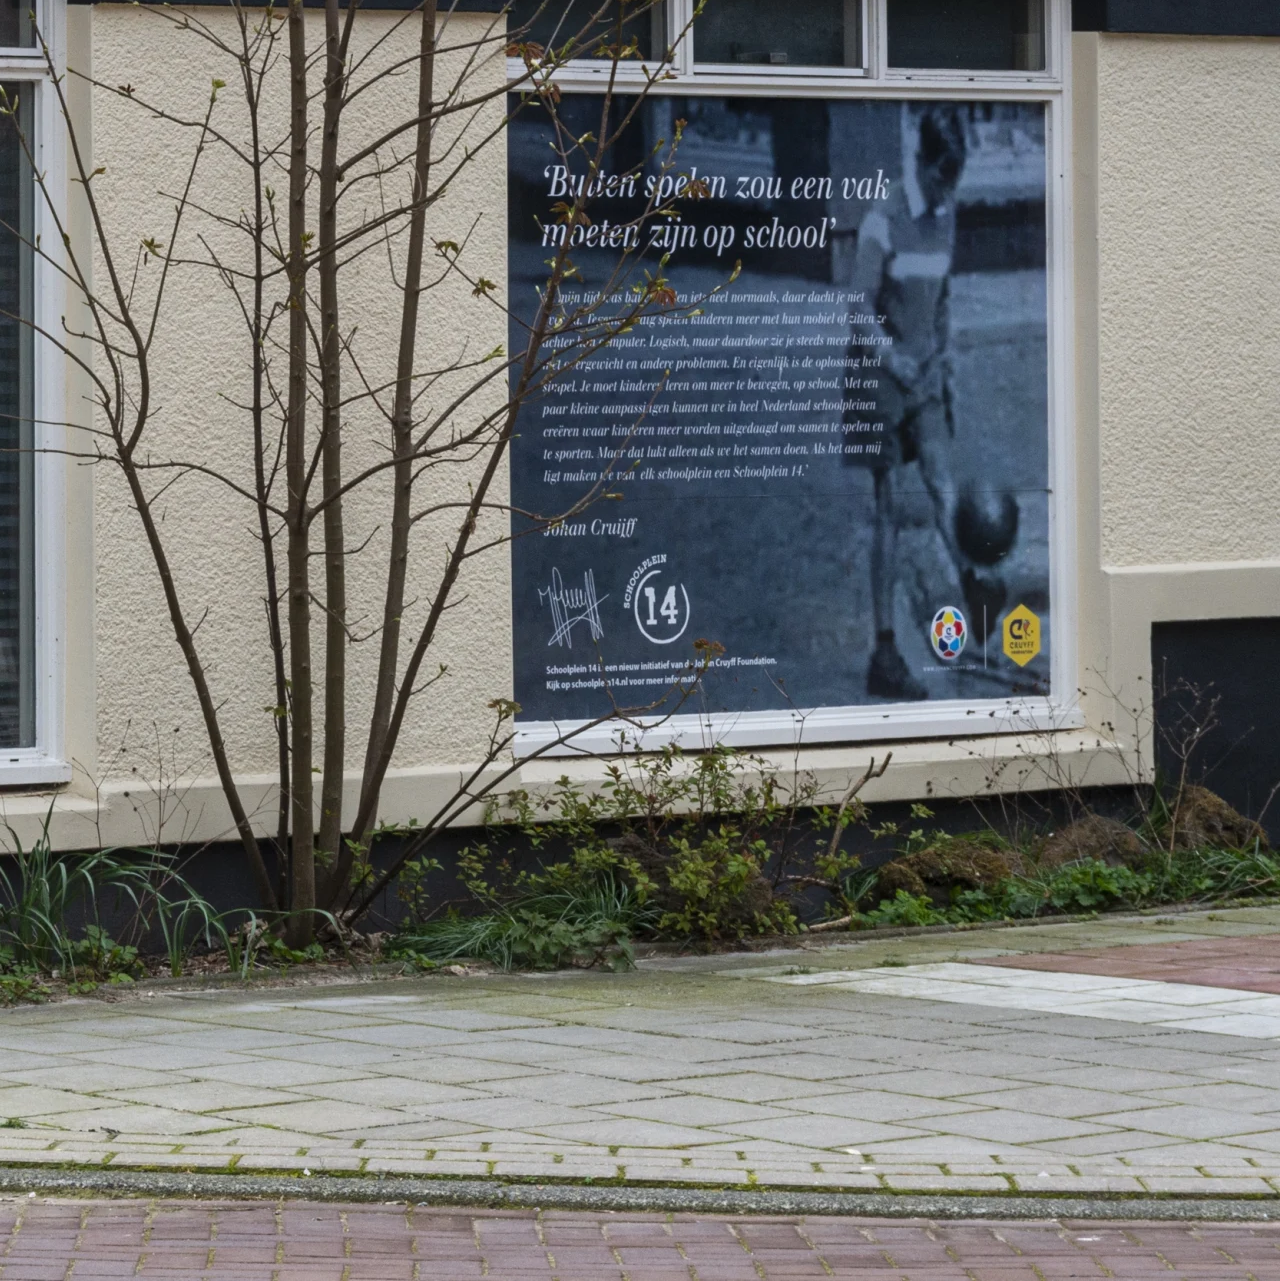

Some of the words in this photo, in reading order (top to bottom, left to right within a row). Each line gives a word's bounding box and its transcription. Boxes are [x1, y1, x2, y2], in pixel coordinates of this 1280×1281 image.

[736, 176, 783, 200] zou
[790, 175, 834, 199] een
[841, 169, 890, 200] vak
[649, 217, 697, 254] zijn
[703, 223, 735, 256] op
[544, 425, 580, 437] creëren
[582, 427, 609, 437] waar
[657, 426, 681, 435] meer
[683, 422, 721, 435] worden
[723, 421, 778, 437] uitgedaagd
[780, 424, 795, 433] om
[797, 424, 828, 433] samen
[830, 421, 839, 432] te
[841, 420, 870, 435] spelen
[872, 423, 883, 432] en
[544, 448, 553, 459] te
[627, 446, 645, 458] dat
[646, 445, 666, 458] lukt
[668, 445, 698, 457] alleen
[700, 444, 715, 457] als
[716, 447, 731, 456] we
[732, 444, 748, 456] het
[750, 446, 781, 456] samen
[811, 442, 826, 455] Als
[828, 442, 843, 454] het
[844, 445, 863, 454] aan
[865, 441, 881, 457] mij
[544, 470, 560, 486] ligt
[562, 469, 597, 482] maken
[638, 468, 655, 480] elk
[657, 466, 712, 483] schoolplein
[714, 469, 730, 478] een
[732, 465, 789, 481] Schoolplein
[591, 518, 638, 538] Cruijff
[623, 554, 667, 609] SCHOOLPLEIN
[644, 585, 679, 625] 14
[546, 663, 587, 676] Schoolplein
[588, 663, 596, 672] 14
[598, 663, 603, 672] i
[605, 664, 617, 672] een
[619, 661, 639, 671] nieuw
[641, 660, 669, 670] initiatief
[671, 661, 683, 669] van
[685, 659, 693, 669] d
[716, 657, 736, 669] Cruyff
[546, 679, 560, 691] Kijk
[561, 680, 570, 690] op
[572, 676, 628, 689] schoolplen14.nl
[629, 677, 644, 685] voor
[646, 676, 663, 684] meer
